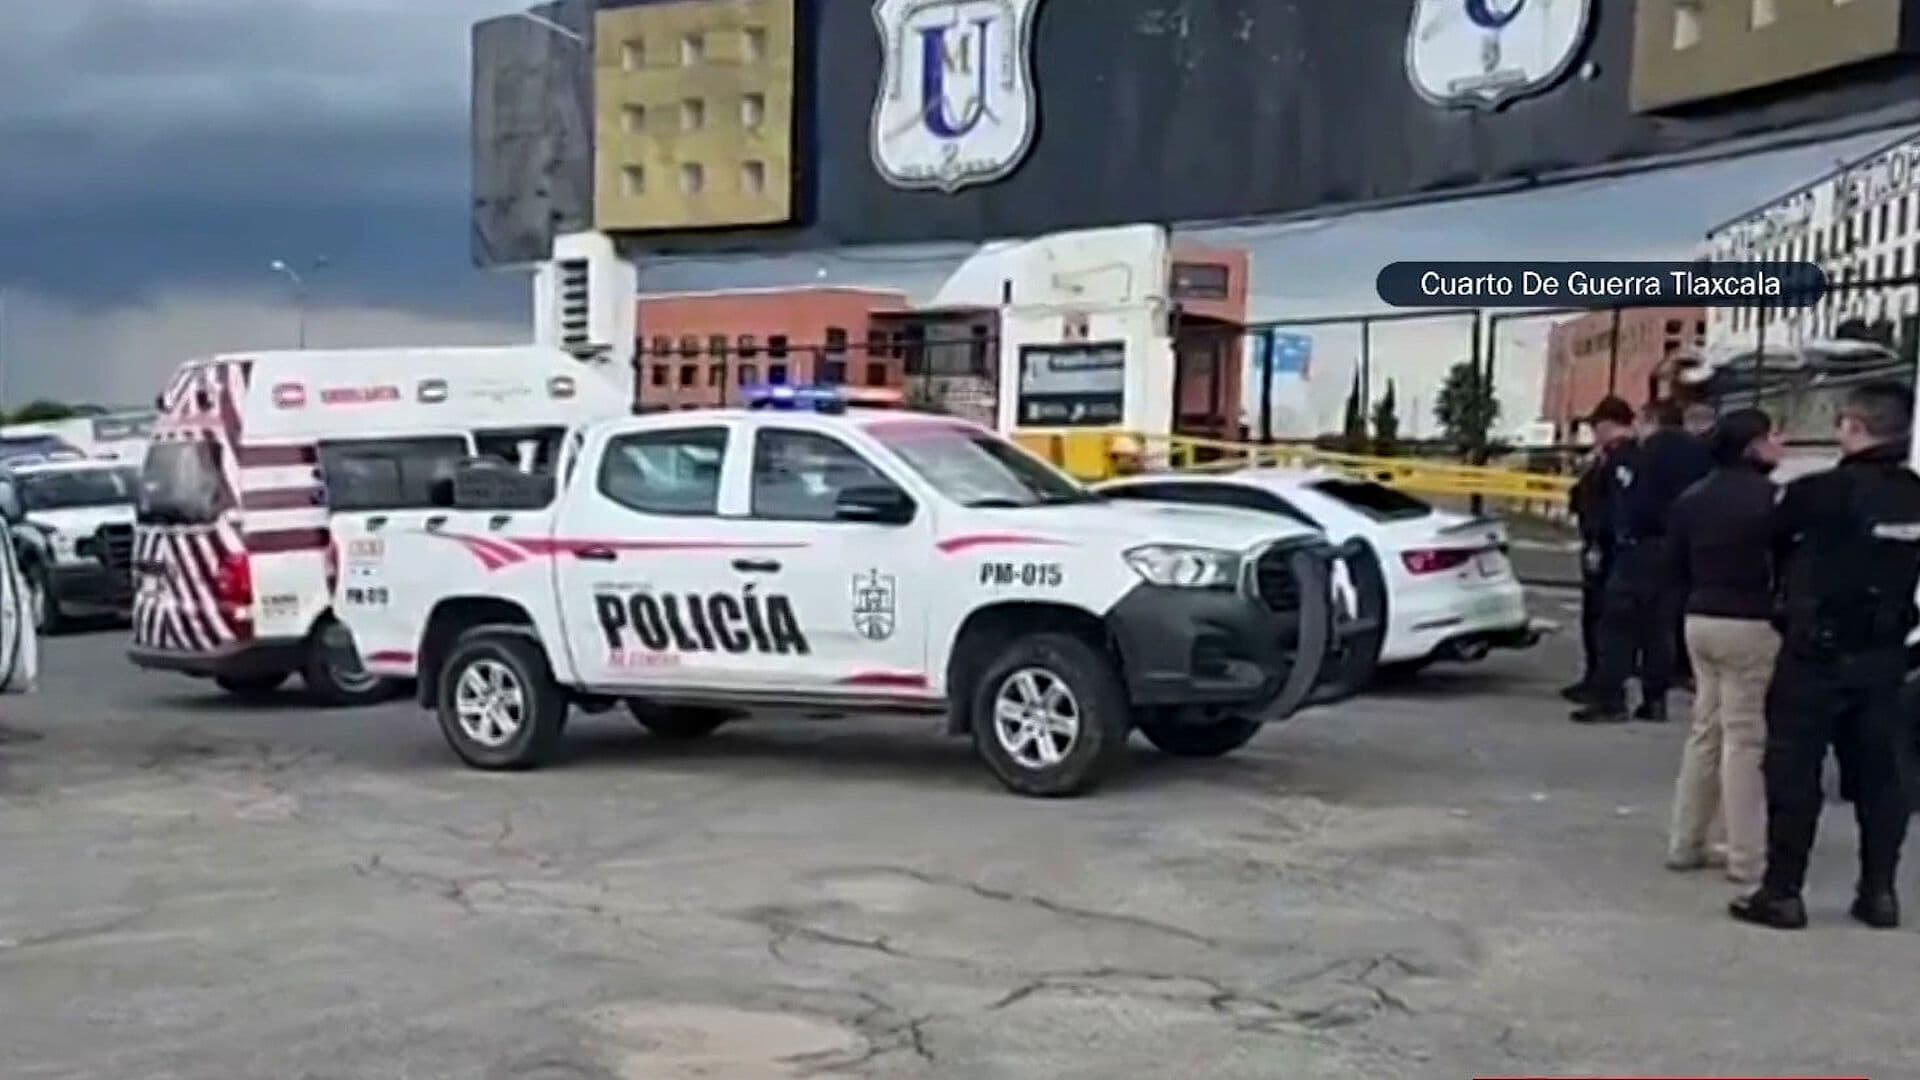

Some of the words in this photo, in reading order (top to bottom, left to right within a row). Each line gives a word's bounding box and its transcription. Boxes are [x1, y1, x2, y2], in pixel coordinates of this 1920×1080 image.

[914, 16, 996, 138] U
[980, 562, 1063, 586] PM-015
[595, 582, 810, 655] POLICÍA
